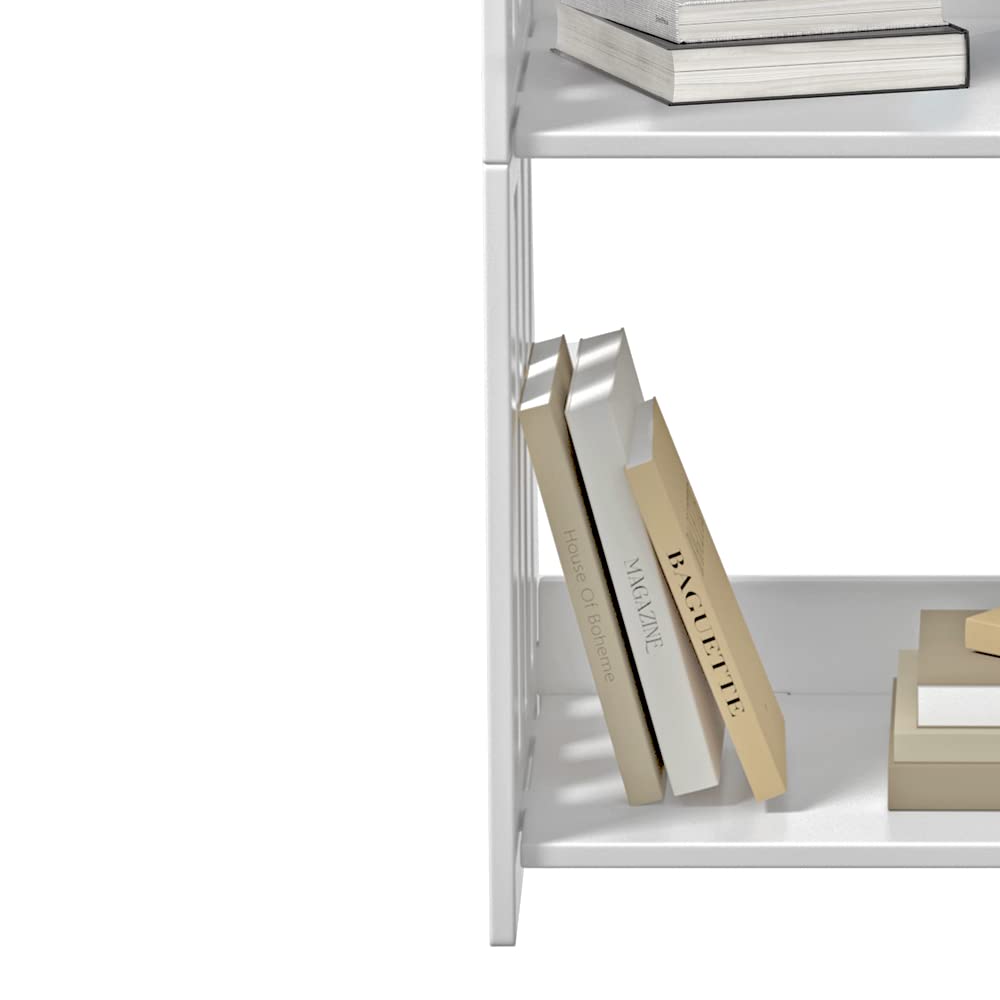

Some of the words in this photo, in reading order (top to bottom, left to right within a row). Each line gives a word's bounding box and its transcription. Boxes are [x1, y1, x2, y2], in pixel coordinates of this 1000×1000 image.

[563, 528, 587, 583] House
[581, 587, 599, 609] Of
[624, 557, 664, 655] MAGAZINE
[587, 614, 616, 683] Boheme
[668, 551, 746, 718] BAGUETTE
